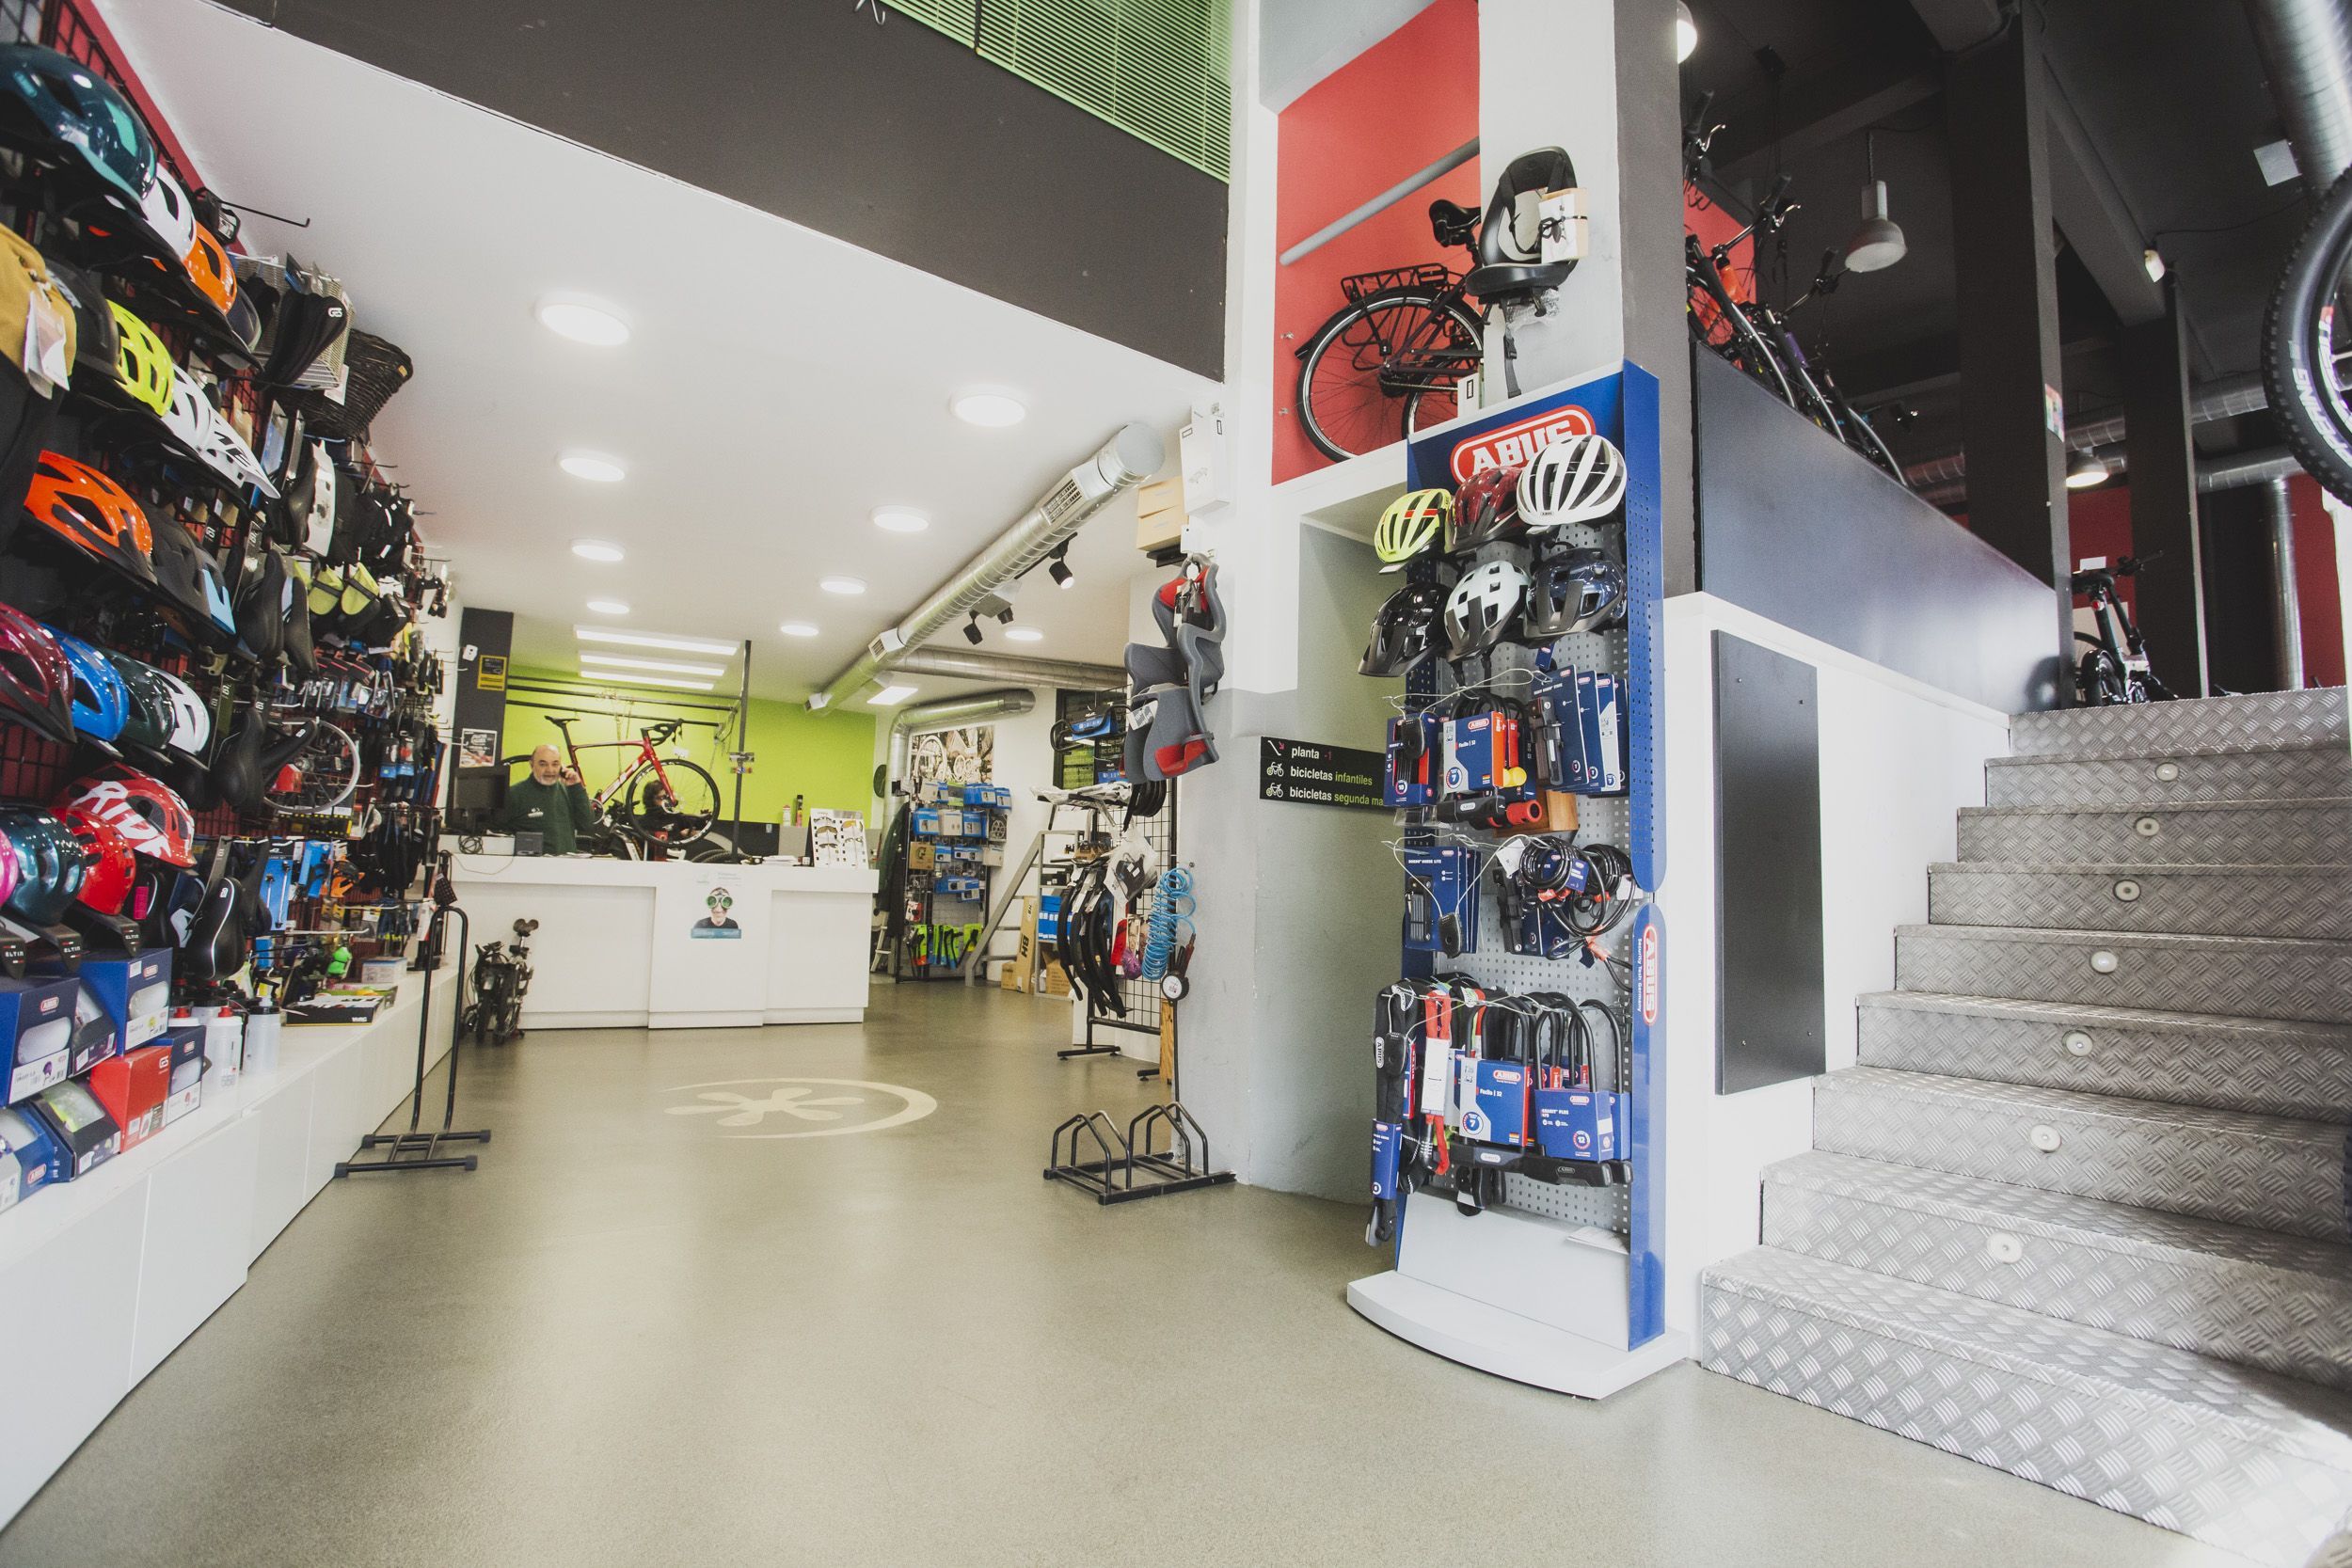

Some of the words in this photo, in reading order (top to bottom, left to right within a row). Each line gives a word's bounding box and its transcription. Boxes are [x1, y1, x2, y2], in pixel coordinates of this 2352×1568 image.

[1291, 746, 1320, 760] planta
[1324, 752, 1333, 761] -1
[1290, 766, 1333, 782] bicicletas
[1335, 771, 1373, 786] infantiles
[1290, 786, 1332, 801] bicicletas
[1334, 792, 1370, 806] segunda
[1645, 938, 1655, 1011] ABUS
